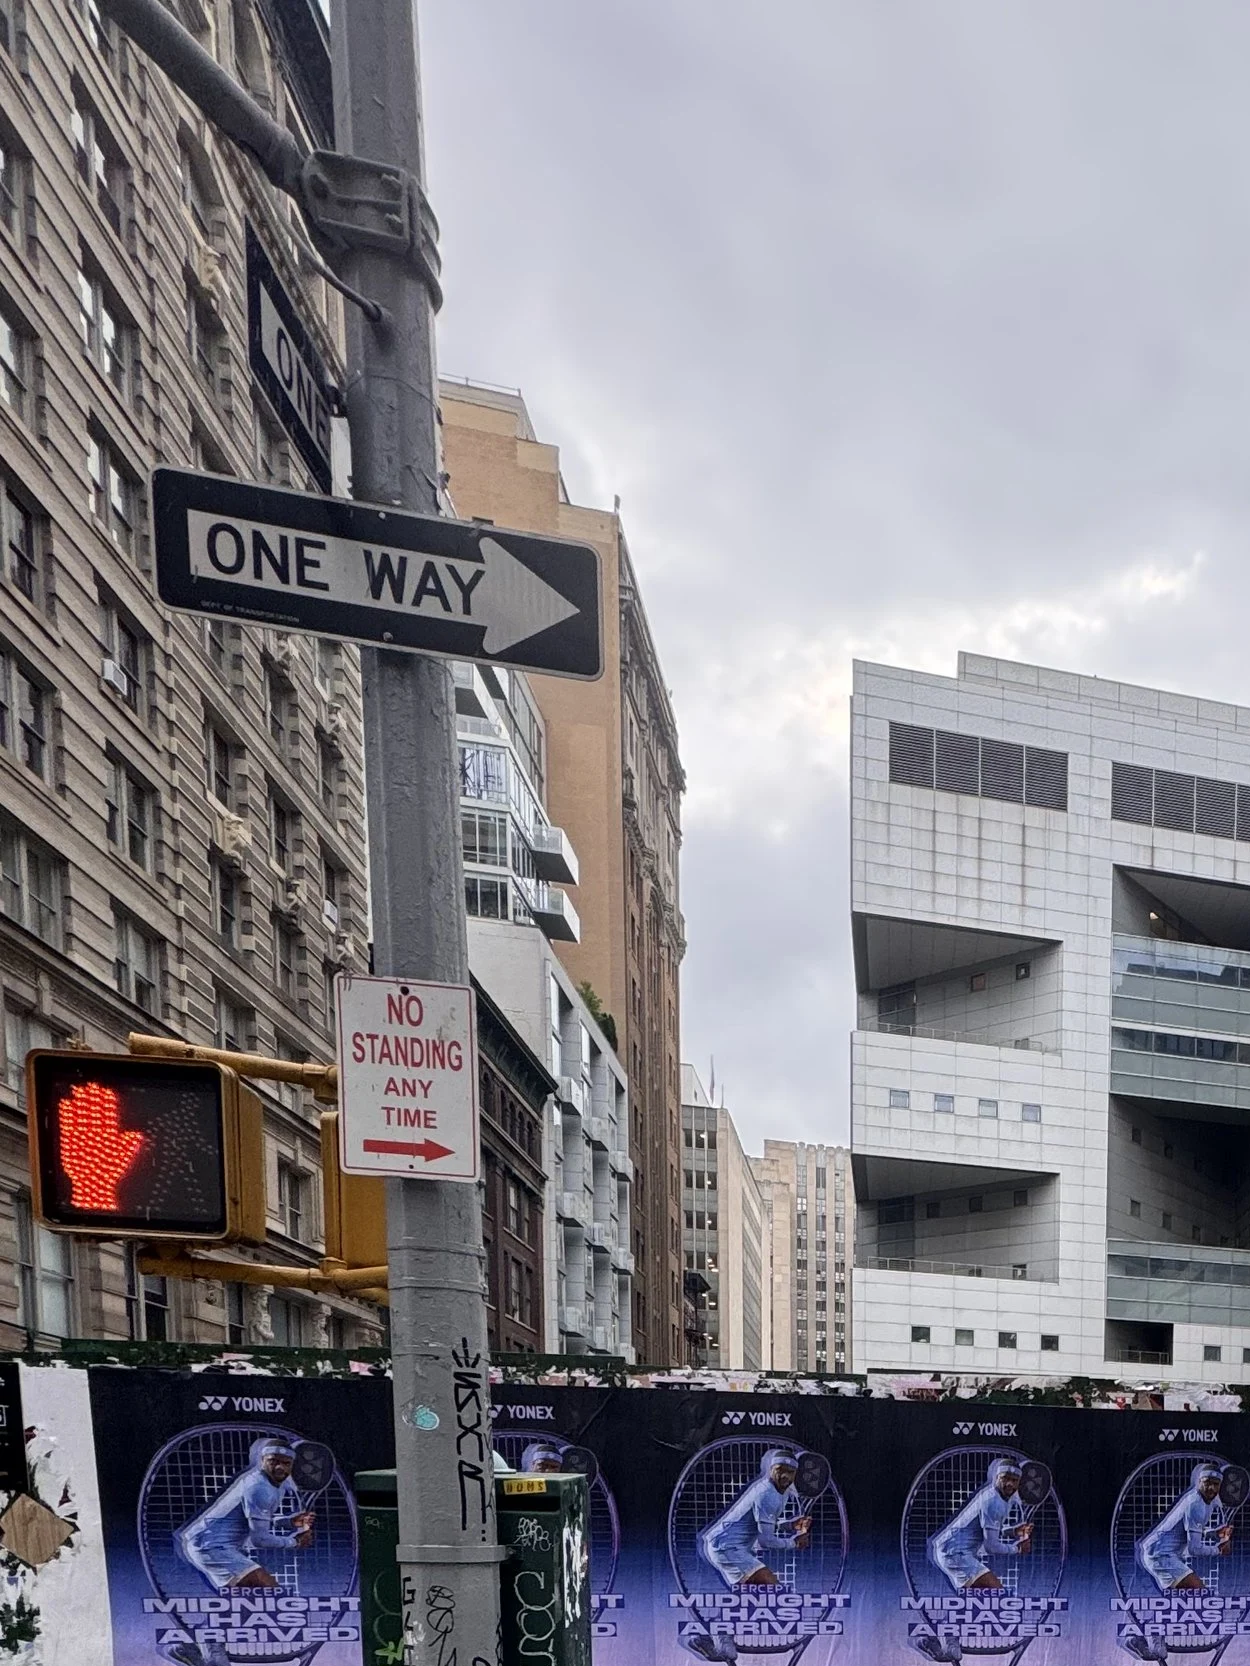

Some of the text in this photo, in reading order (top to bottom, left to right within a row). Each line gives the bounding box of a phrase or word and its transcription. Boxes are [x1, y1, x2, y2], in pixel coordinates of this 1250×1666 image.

[277, 327, 328, 449] ONE
[206, 522, 485, 616] ONE WAY
[235, 606, 300, 622] TRANSPORTATION
[387, 993, 424, 1027] NO
[352, 1032, 463, 1071] STANDING
[384, 1077, 433, 1099] ANY
[381, 1106, 438, 1129] TIME
[231, 1397, 285, 1412] YONEX
[507, 1405, 554, 1420] YONEX
[749, 1412, 792, 1427] YONEX
[977, 1422, 1017, 1437] YONEX
[1182, 1429, 1218, 1442] YONEX
[219, 1586, 293, 1597] PERCEPT
[732, 1584, 790, 1593] PERCEPT
[957, 1588, 1013, 1596] PERCEPT
[1163, 1588, 1215, 1596] PERCEPT
[143, 1597, 360, 1612] MIDNIGHT
[669, 1594, 850, 1607] MIDNIGHT
[901, 1597, 1067, 1610] MIDNIGHT
[208, 1612, 307, 1627] HAS
[722, 1608, 800, 1621] HAS
[948, 1610, 1021, 1623] HAS
[1154, 1610, 1222, 1622] HAS
[157, 1627, 359, 1643] ARRIVED
[680, 1622, 842, 1635] ARRIVED
[909, 1623, 1060, 1637] ARRIVED
